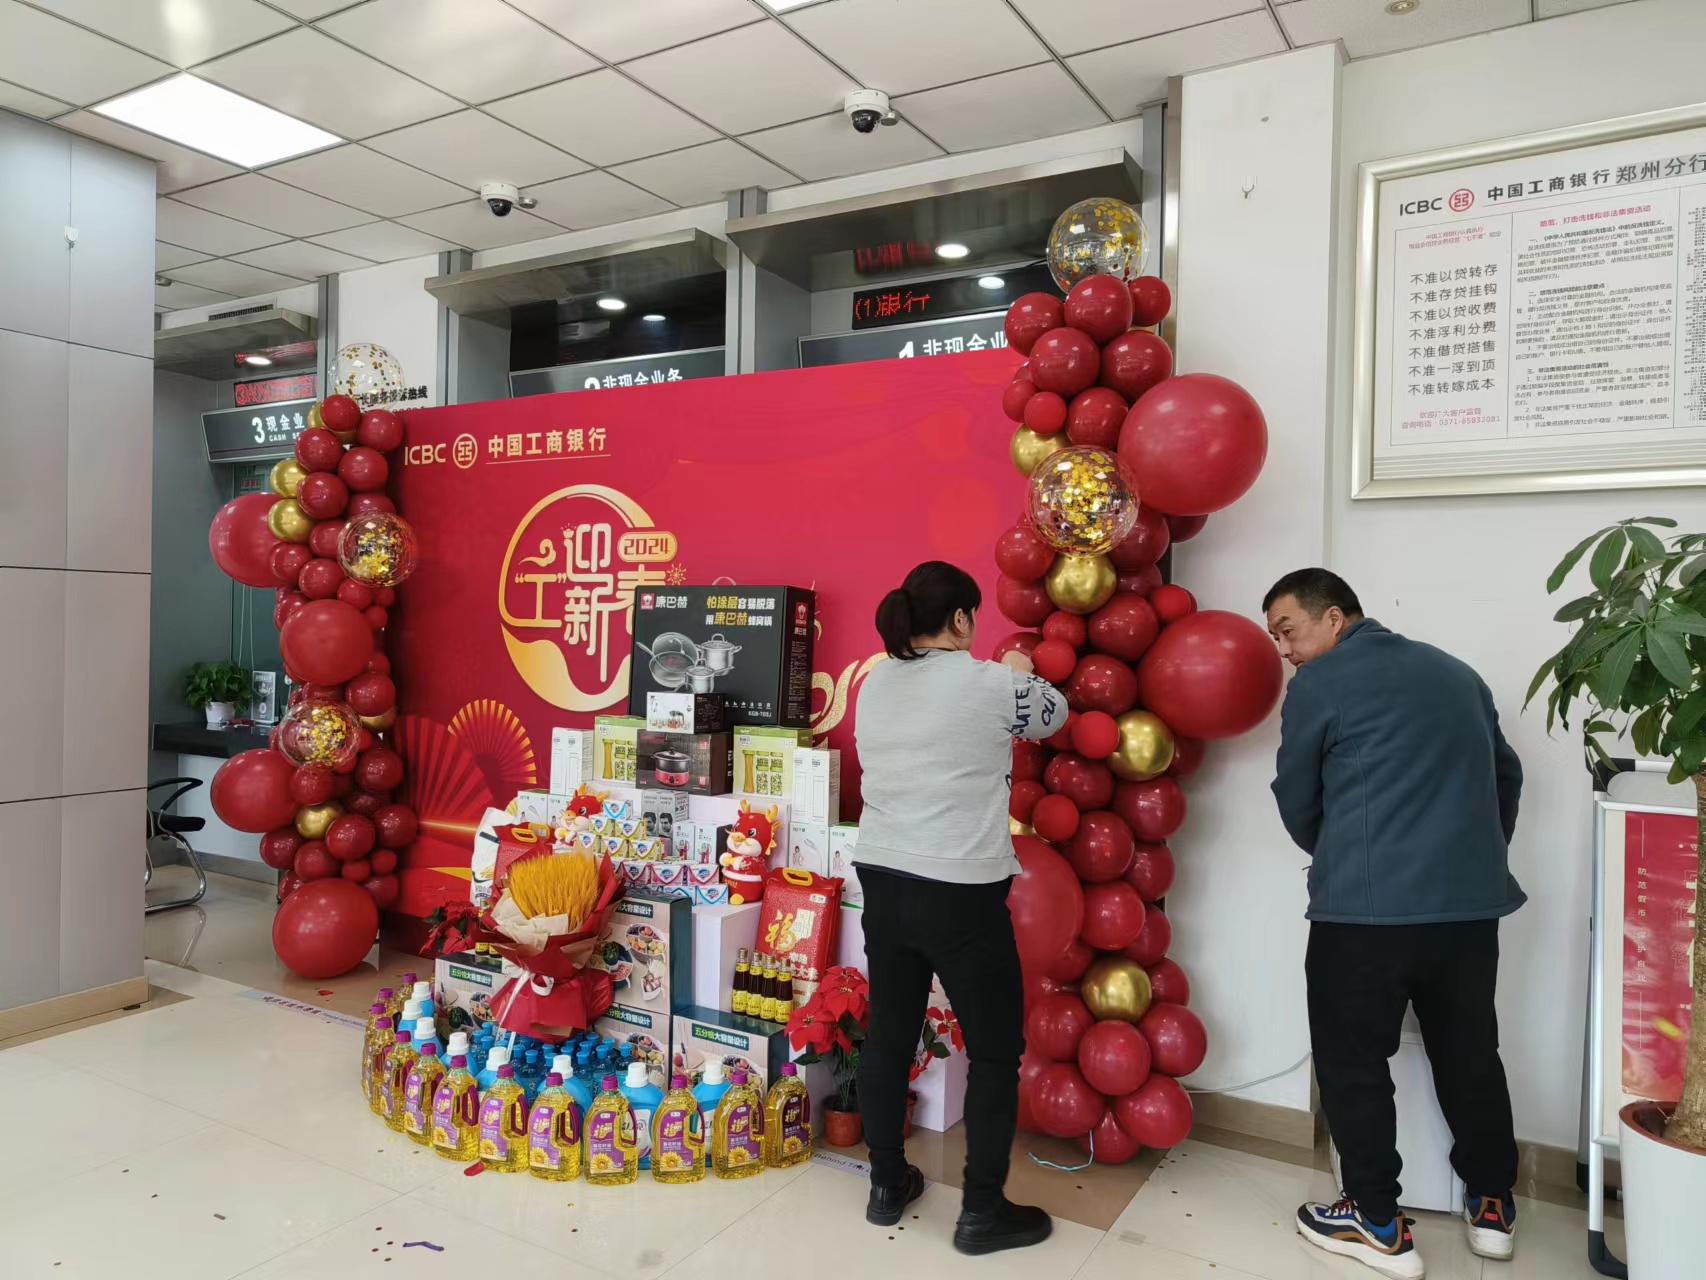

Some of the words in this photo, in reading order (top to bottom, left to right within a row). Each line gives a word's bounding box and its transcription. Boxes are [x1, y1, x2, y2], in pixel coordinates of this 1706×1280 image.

[1400, 197, 1443, 216] ICBC
[1410, 264, 1498, 285] 不准以贷转存
[1410, 283, 1497, 304] 不准存贷挂钩
[1409, 302, 1497, 322] 不准以贷收费
[1409, 321, 1496, 340] 不准浮利分费
[1408, 340, 1496, 359] 不准借贷搭售
[1408, 359, 1496, 377] 不准一浮到顶
[1408, 378, 1495, 396] 不准转嫁成本
[252, 416, 265, 443] 3
[269, 434, 287, 442] CASH
[488, 427, 606, 458] 中国工商银行
[405, 443, 447, 465] ICBC
[623, 537, 671, 555] 2024
[655, 595, 688, 609] 康巴赫
